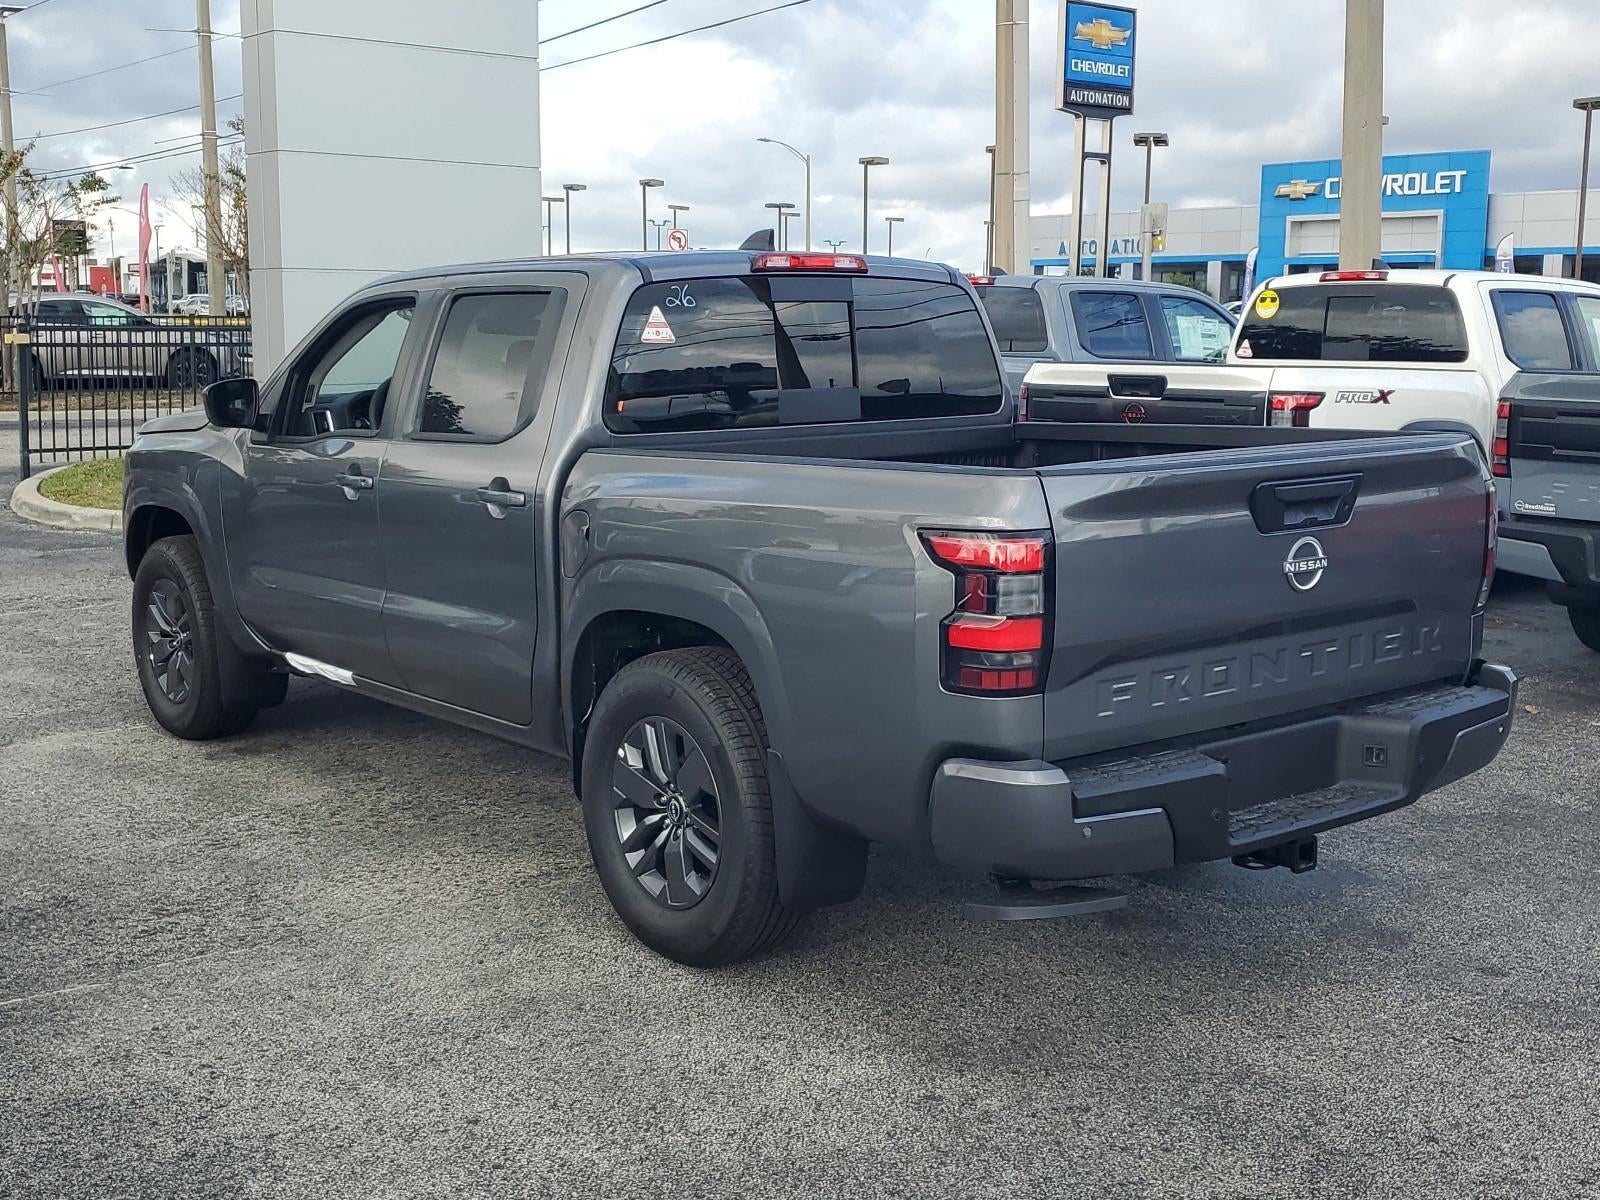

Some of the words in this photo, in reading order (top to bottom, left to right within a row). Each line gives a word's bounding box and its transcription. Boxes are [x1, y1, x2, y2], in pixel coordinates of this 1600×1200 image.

[1071, 59, 1130, 77] CHEVROLET
[1070, 89, 1130, 107] AUTONATION
[1324, 170, 1467, 199] CROLET
[665, 283, 697, 307] 26
[1285, 558, 1328, 572] NISSAN
[1096, 625, 1442, 717] FRONTIER
